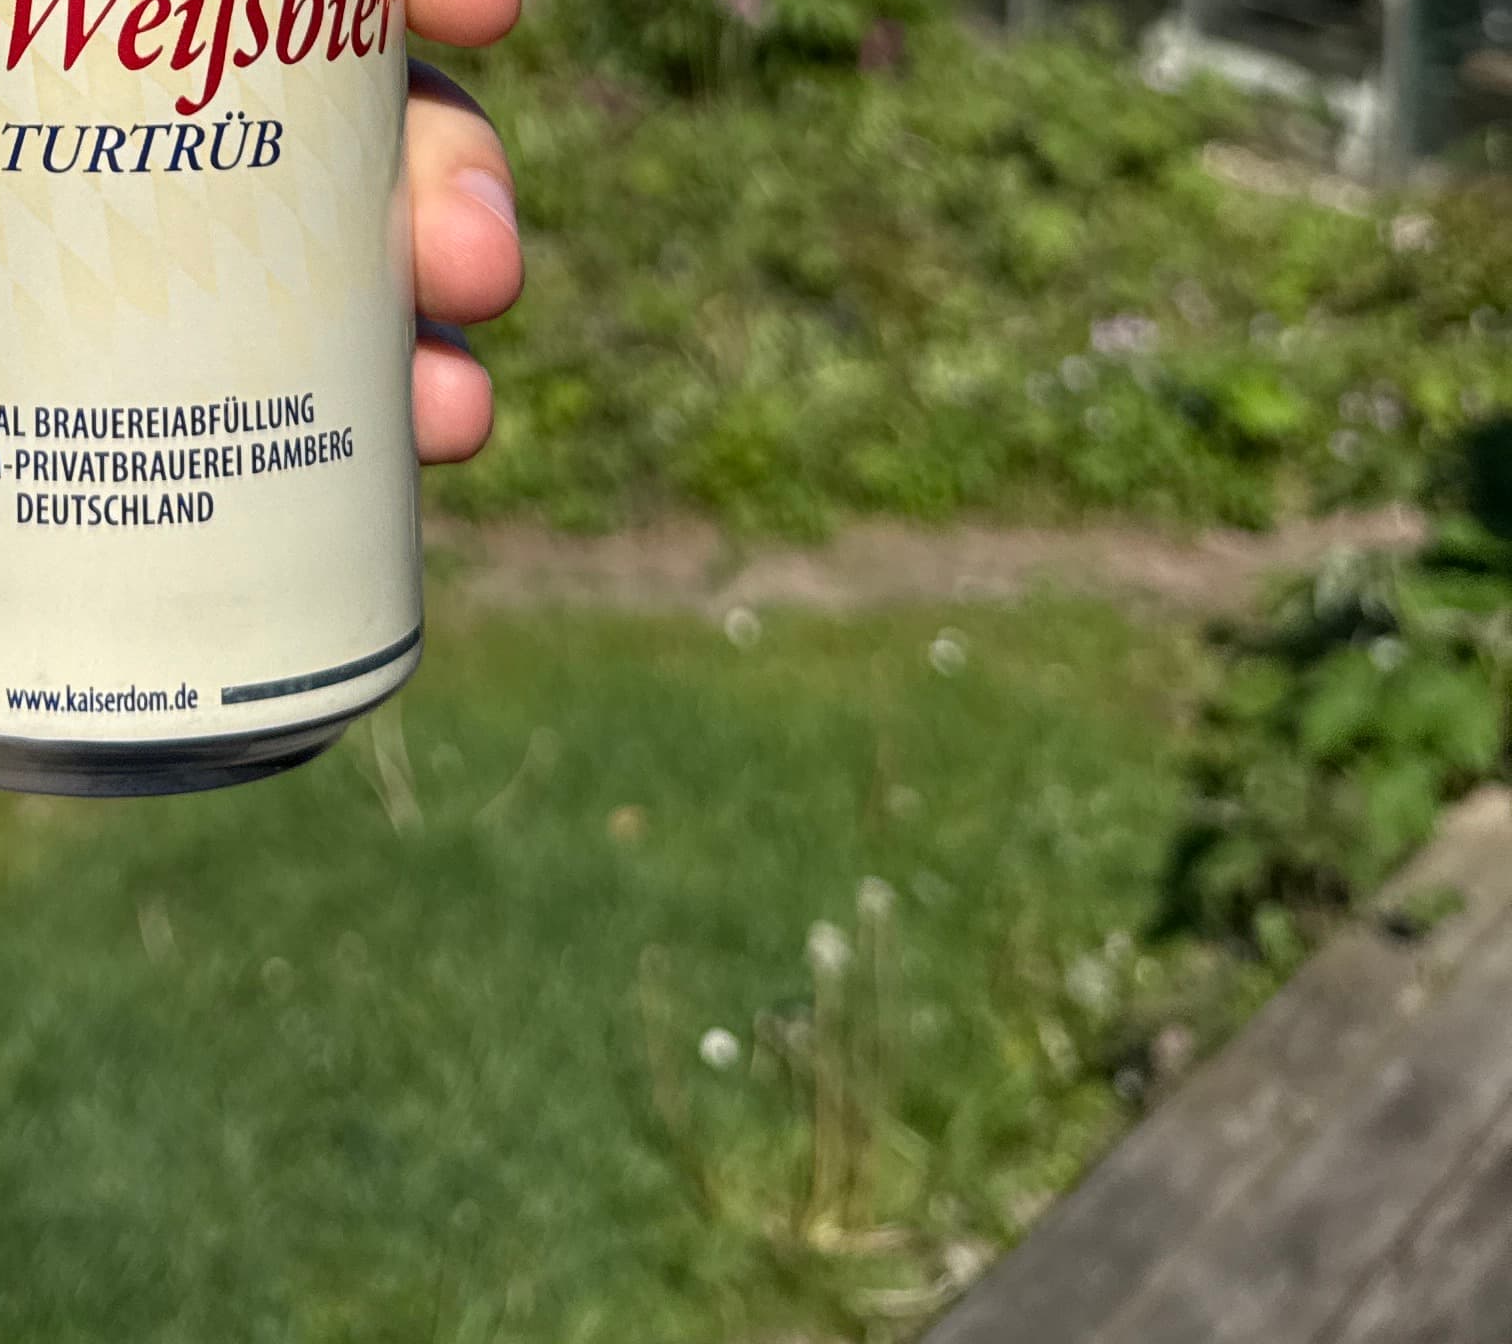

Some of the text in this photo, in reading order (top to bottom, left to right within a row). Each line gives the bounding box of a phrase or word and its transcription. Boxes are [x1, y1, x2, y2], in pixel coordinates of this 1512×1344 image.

[34, 391, 316, 439] BRAUEREIABFÜLLUNG
[251, 427, 355, 475] BAMBERG
[16, 490, 215, 526] DEUTSCHLAND
[6, 682, 199, 712] www.kaiserdom.de
